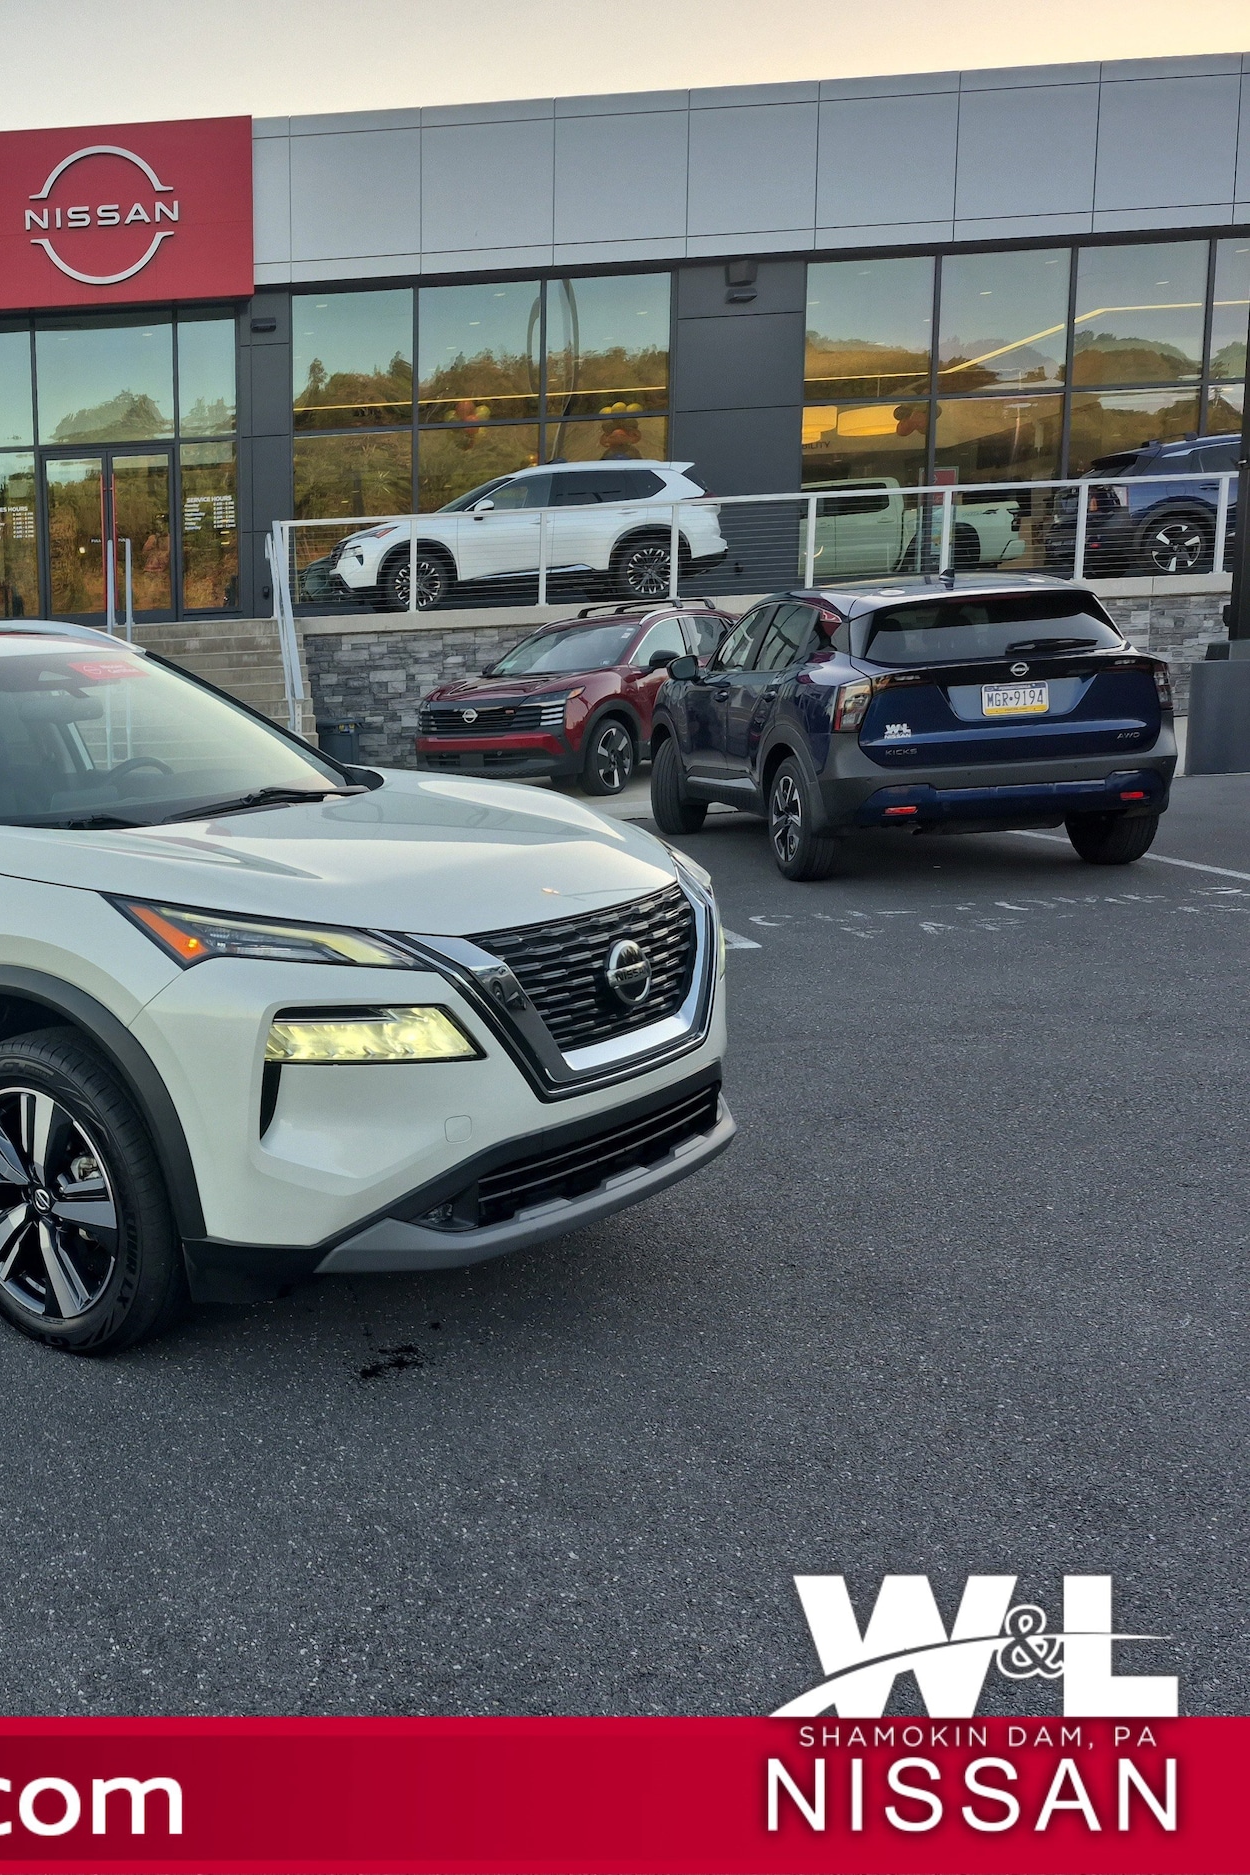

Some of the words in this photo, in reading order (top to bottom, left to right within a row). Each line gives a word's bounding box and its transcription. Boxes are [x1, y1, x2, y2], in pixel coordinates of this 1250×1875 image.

[24, 200, 179, 231] NISSAN
[1117, 731, 1140, 740] AWD
[885, 748, 918, 757] KICKS
